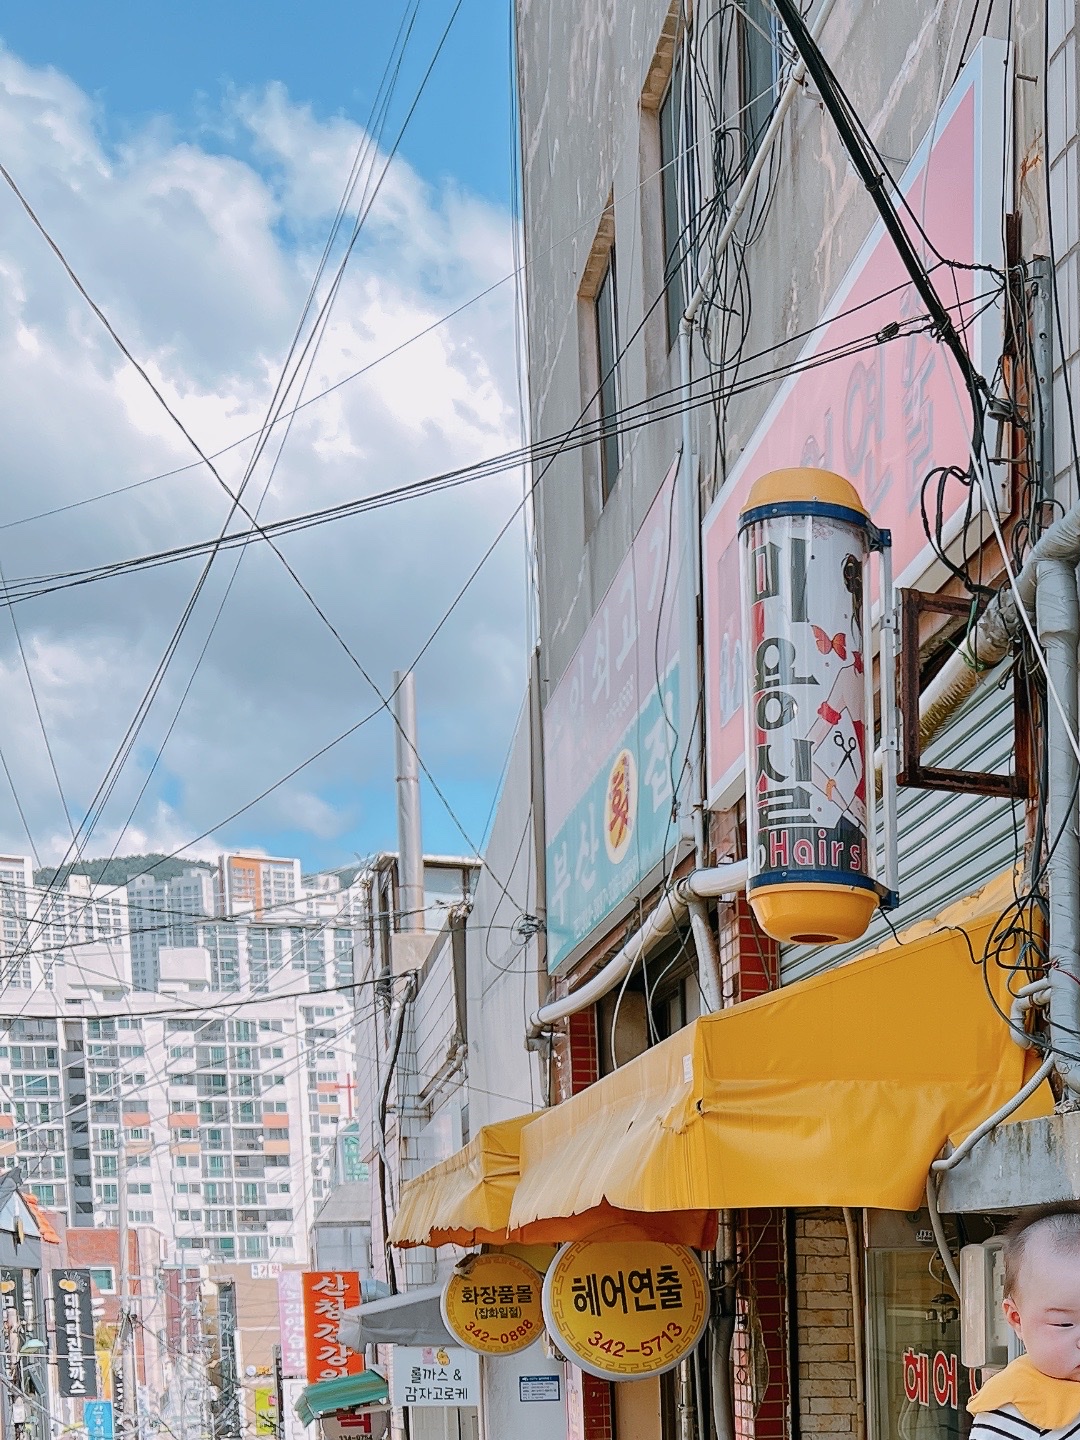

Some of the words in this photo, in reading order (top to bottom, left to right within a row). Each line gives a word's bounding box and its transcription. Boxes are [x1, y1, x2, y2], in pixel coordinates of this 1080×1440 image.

[751, 536, 820, 830] 미용실
[769, 829, 844, 868] Hair
[462, 1285, 533, 1305] 화장품몰
[571, 1265, 683, 1317] 헤어연출
[465, 1319, 533, 1344] 342-0888
[588, 1322, 683, 1358] 342-5713
[453, 1368, 462, 1381] &
[405, 1386, 468, 1402] 감자고로케
